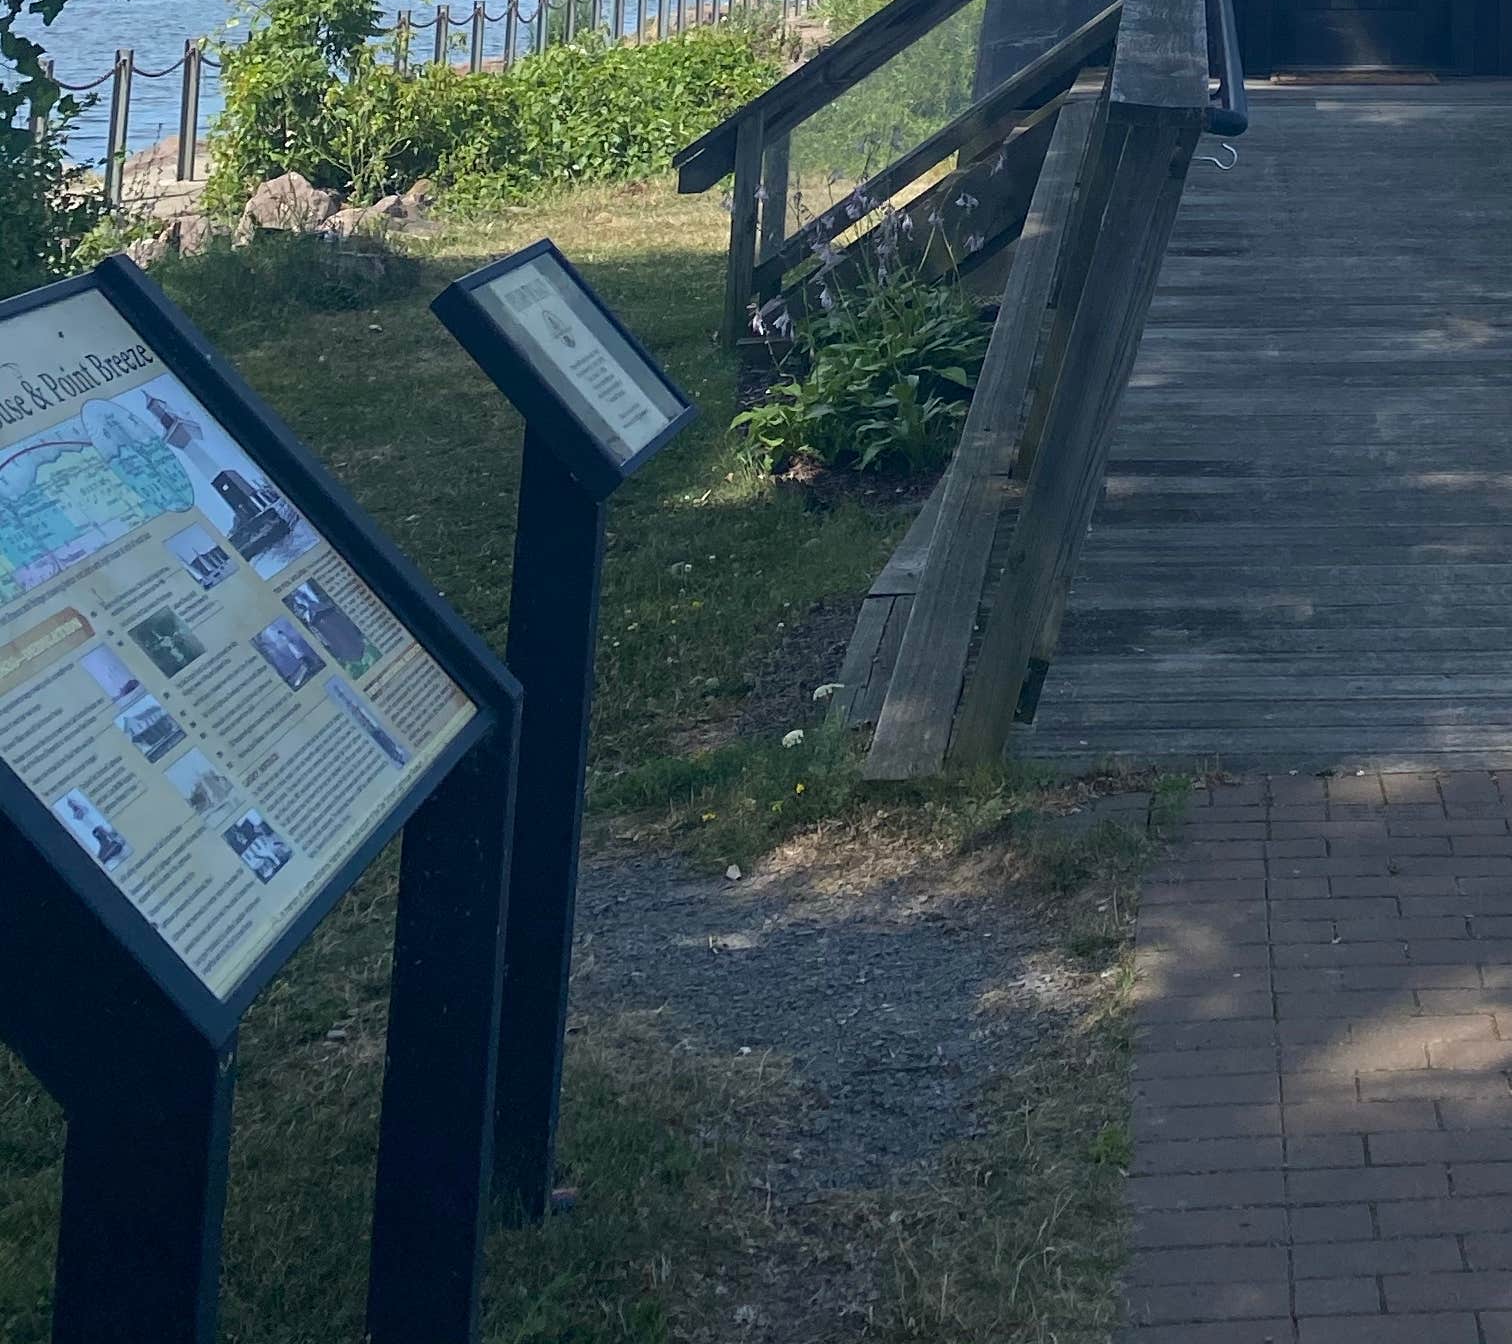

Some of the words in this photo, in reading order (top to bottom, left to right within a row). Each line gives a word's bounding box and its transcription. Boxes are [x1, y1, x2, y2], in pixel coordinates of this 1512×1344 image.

[0, 394, 33, 430] use
[20, 380, 54, 410] &
[37, 362, 102, 403] Point
[84, 344, 154, 382] Breeze
